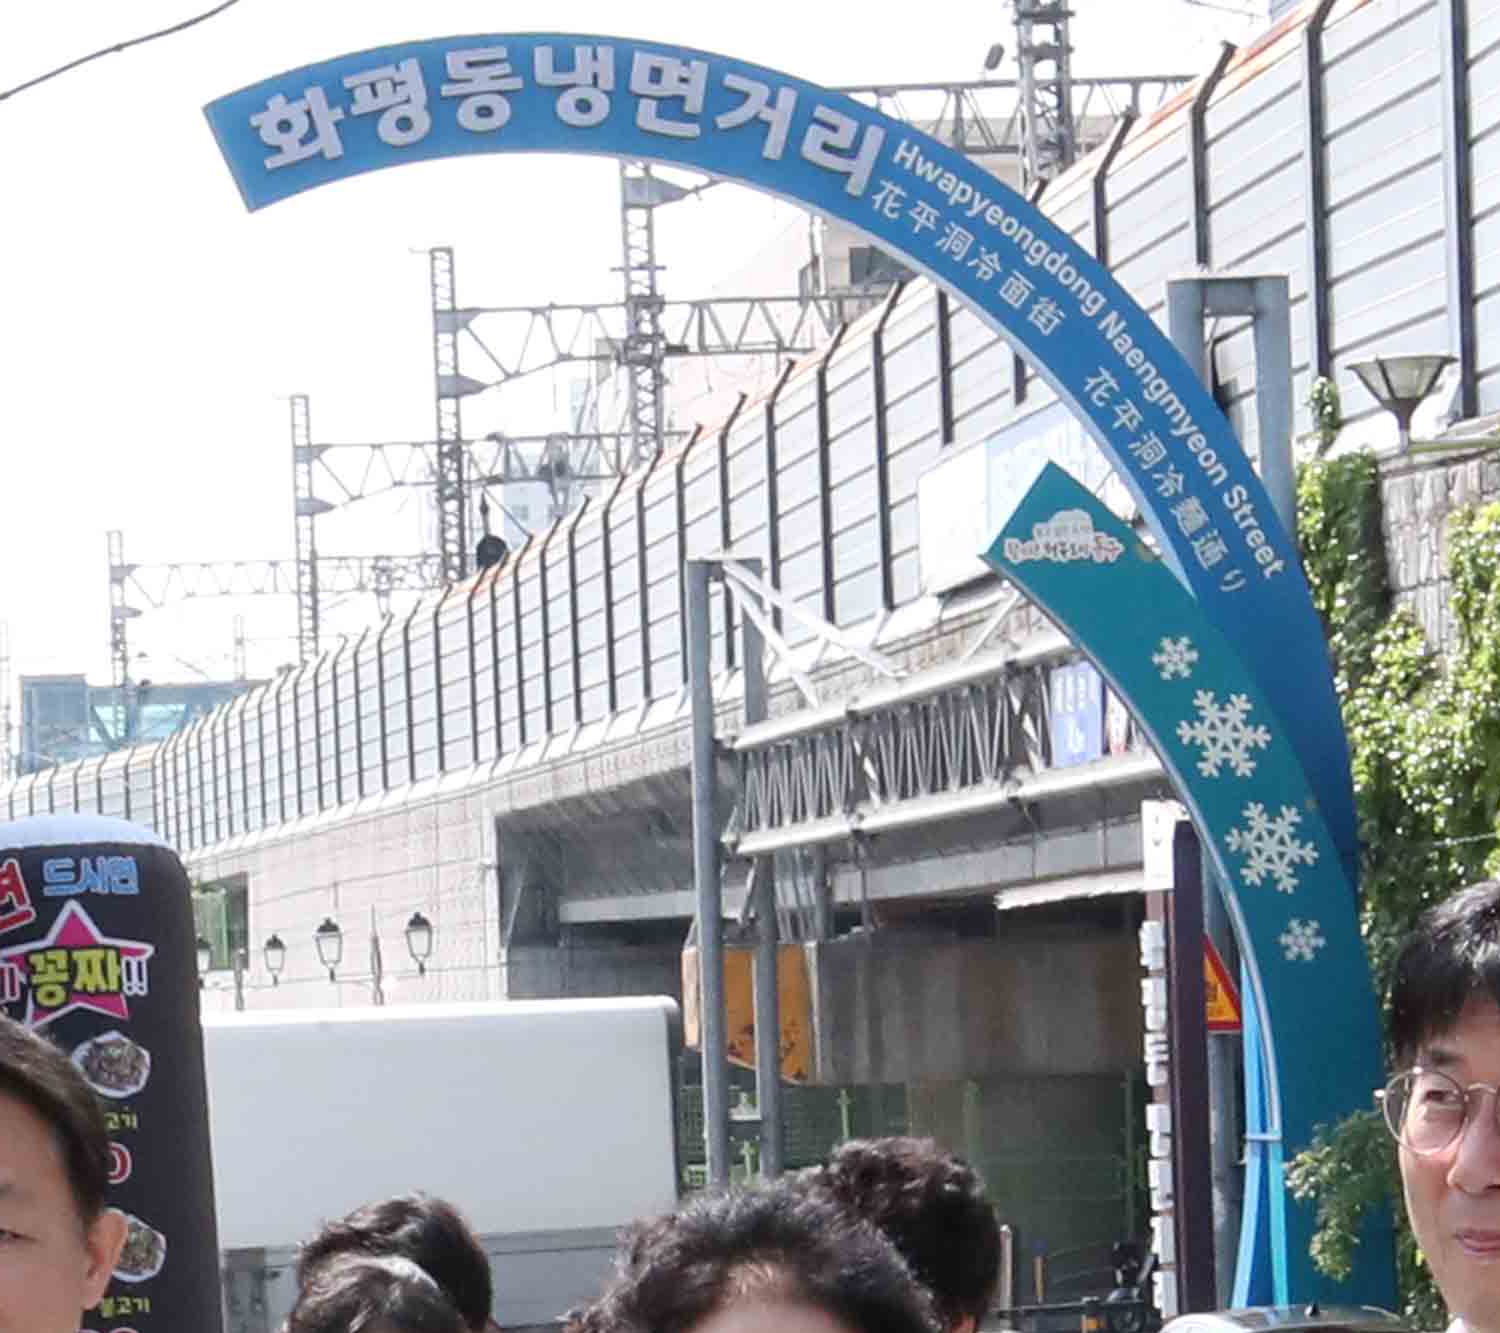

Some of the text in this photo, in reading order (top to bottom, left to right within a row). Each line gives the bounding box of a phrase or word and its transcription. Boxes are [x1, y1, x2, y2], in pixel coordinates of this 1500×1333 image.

[248, 43, 886, 197] 화평동냉면거리
[892, 139, 1287, 579] Hwapyeongdong Naengmyeon Street
